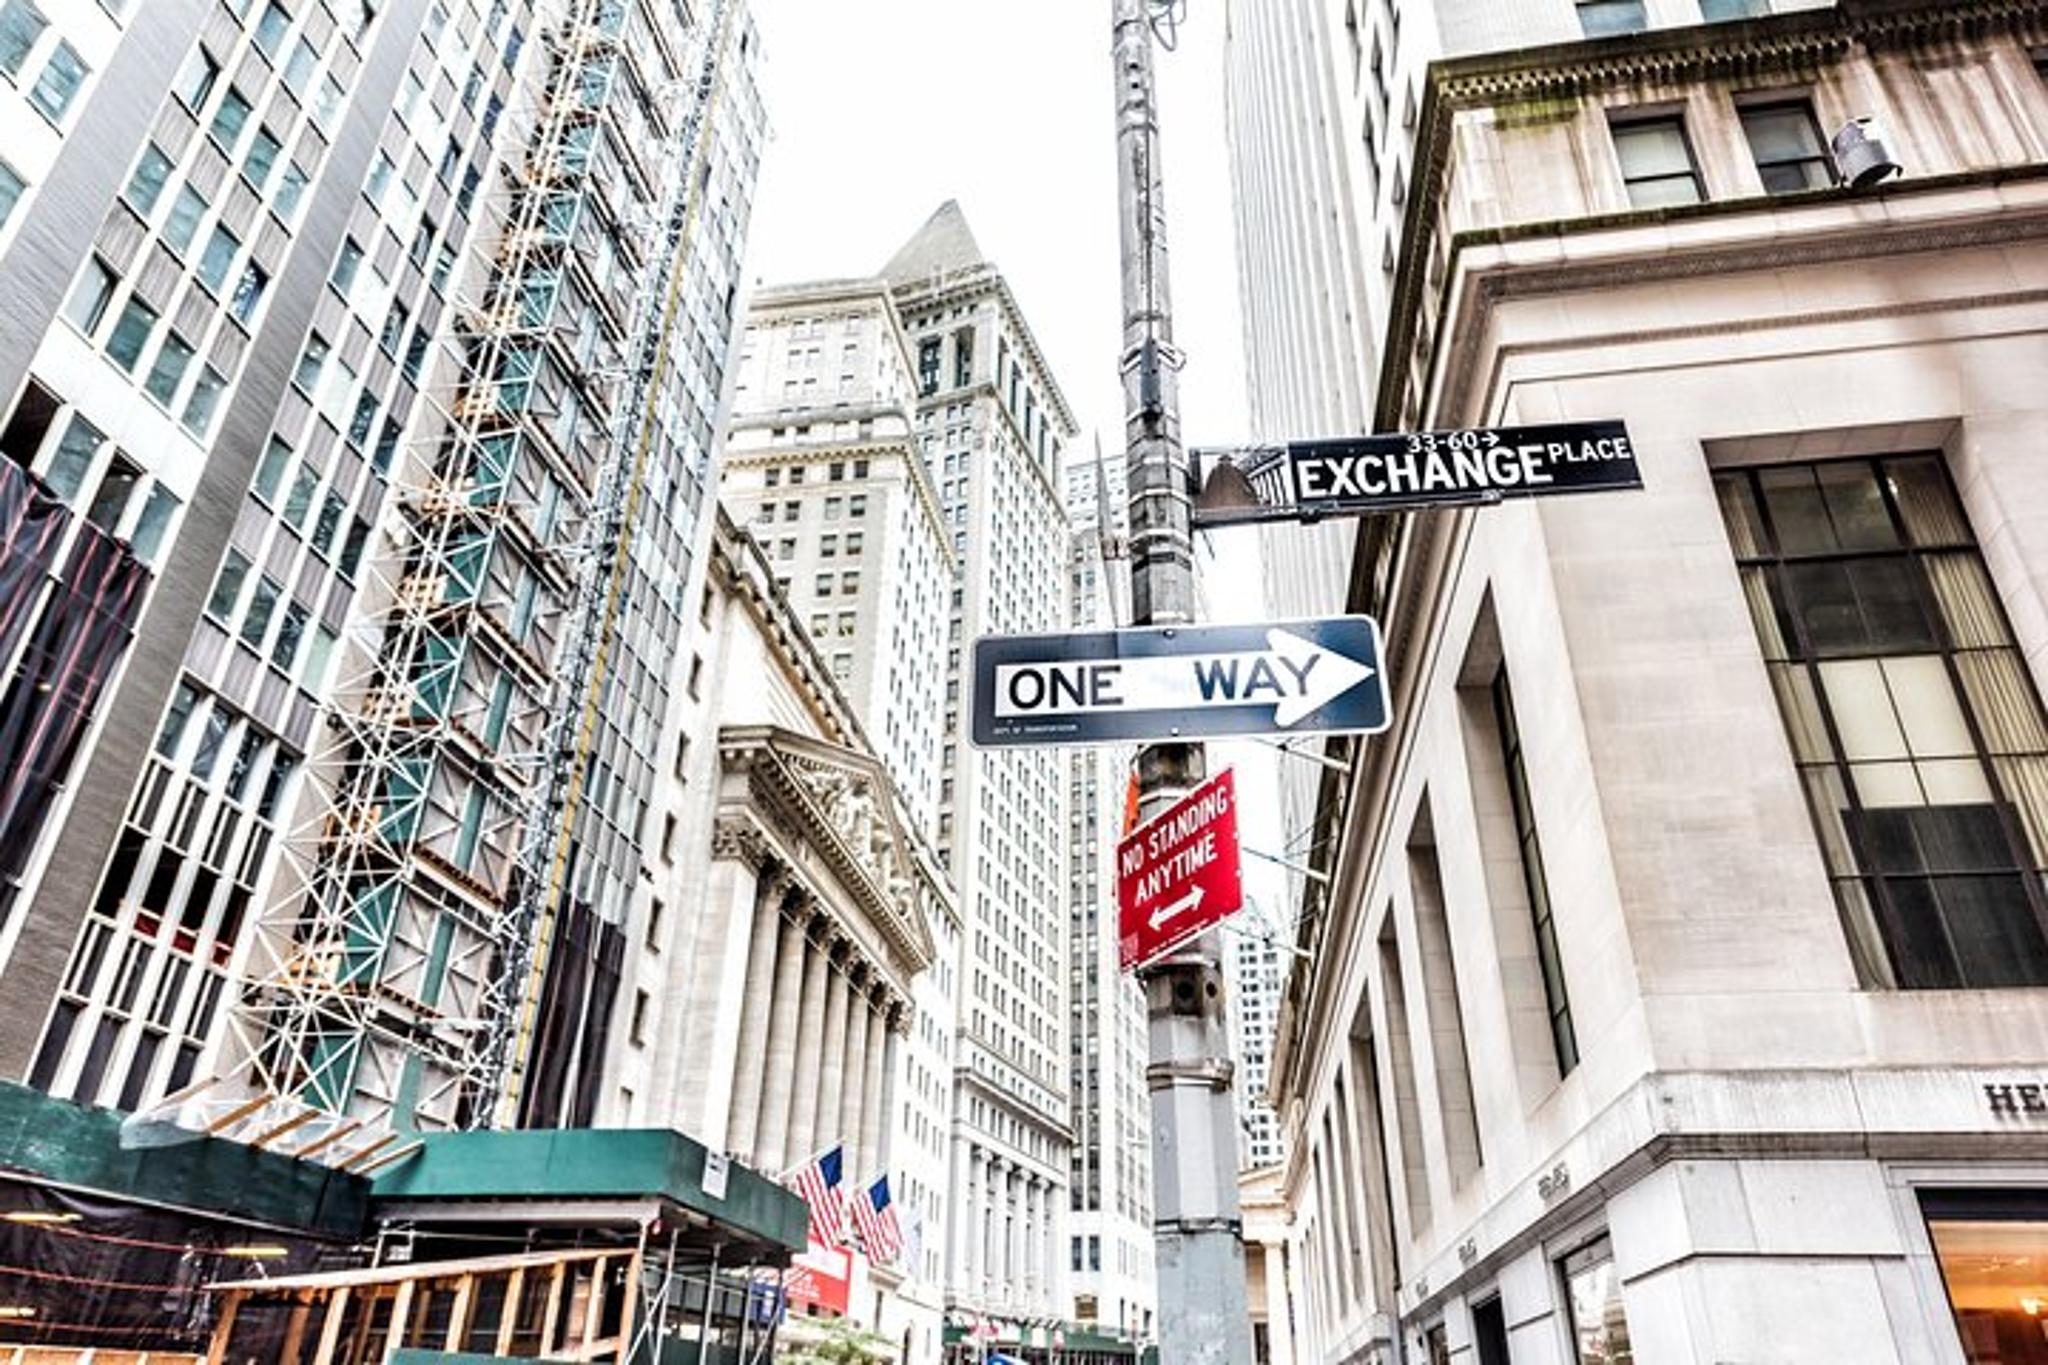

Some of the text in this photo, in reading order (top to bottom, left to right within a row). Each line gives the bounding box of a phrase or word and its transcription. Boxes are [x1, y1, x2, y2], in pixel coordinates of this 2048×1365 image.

[1300, 437, 1631, 498] EXCHANGE PLACE
[1407, 431, 1477, 453] 33-60
[1009, 653, 1321, 709] ONE WAY
[1122, 787, 1228, 878] NO STANDING
[1135, 833, 1218, 907] ANYTIME
[1984, 1084, 2048, 1113] HE
